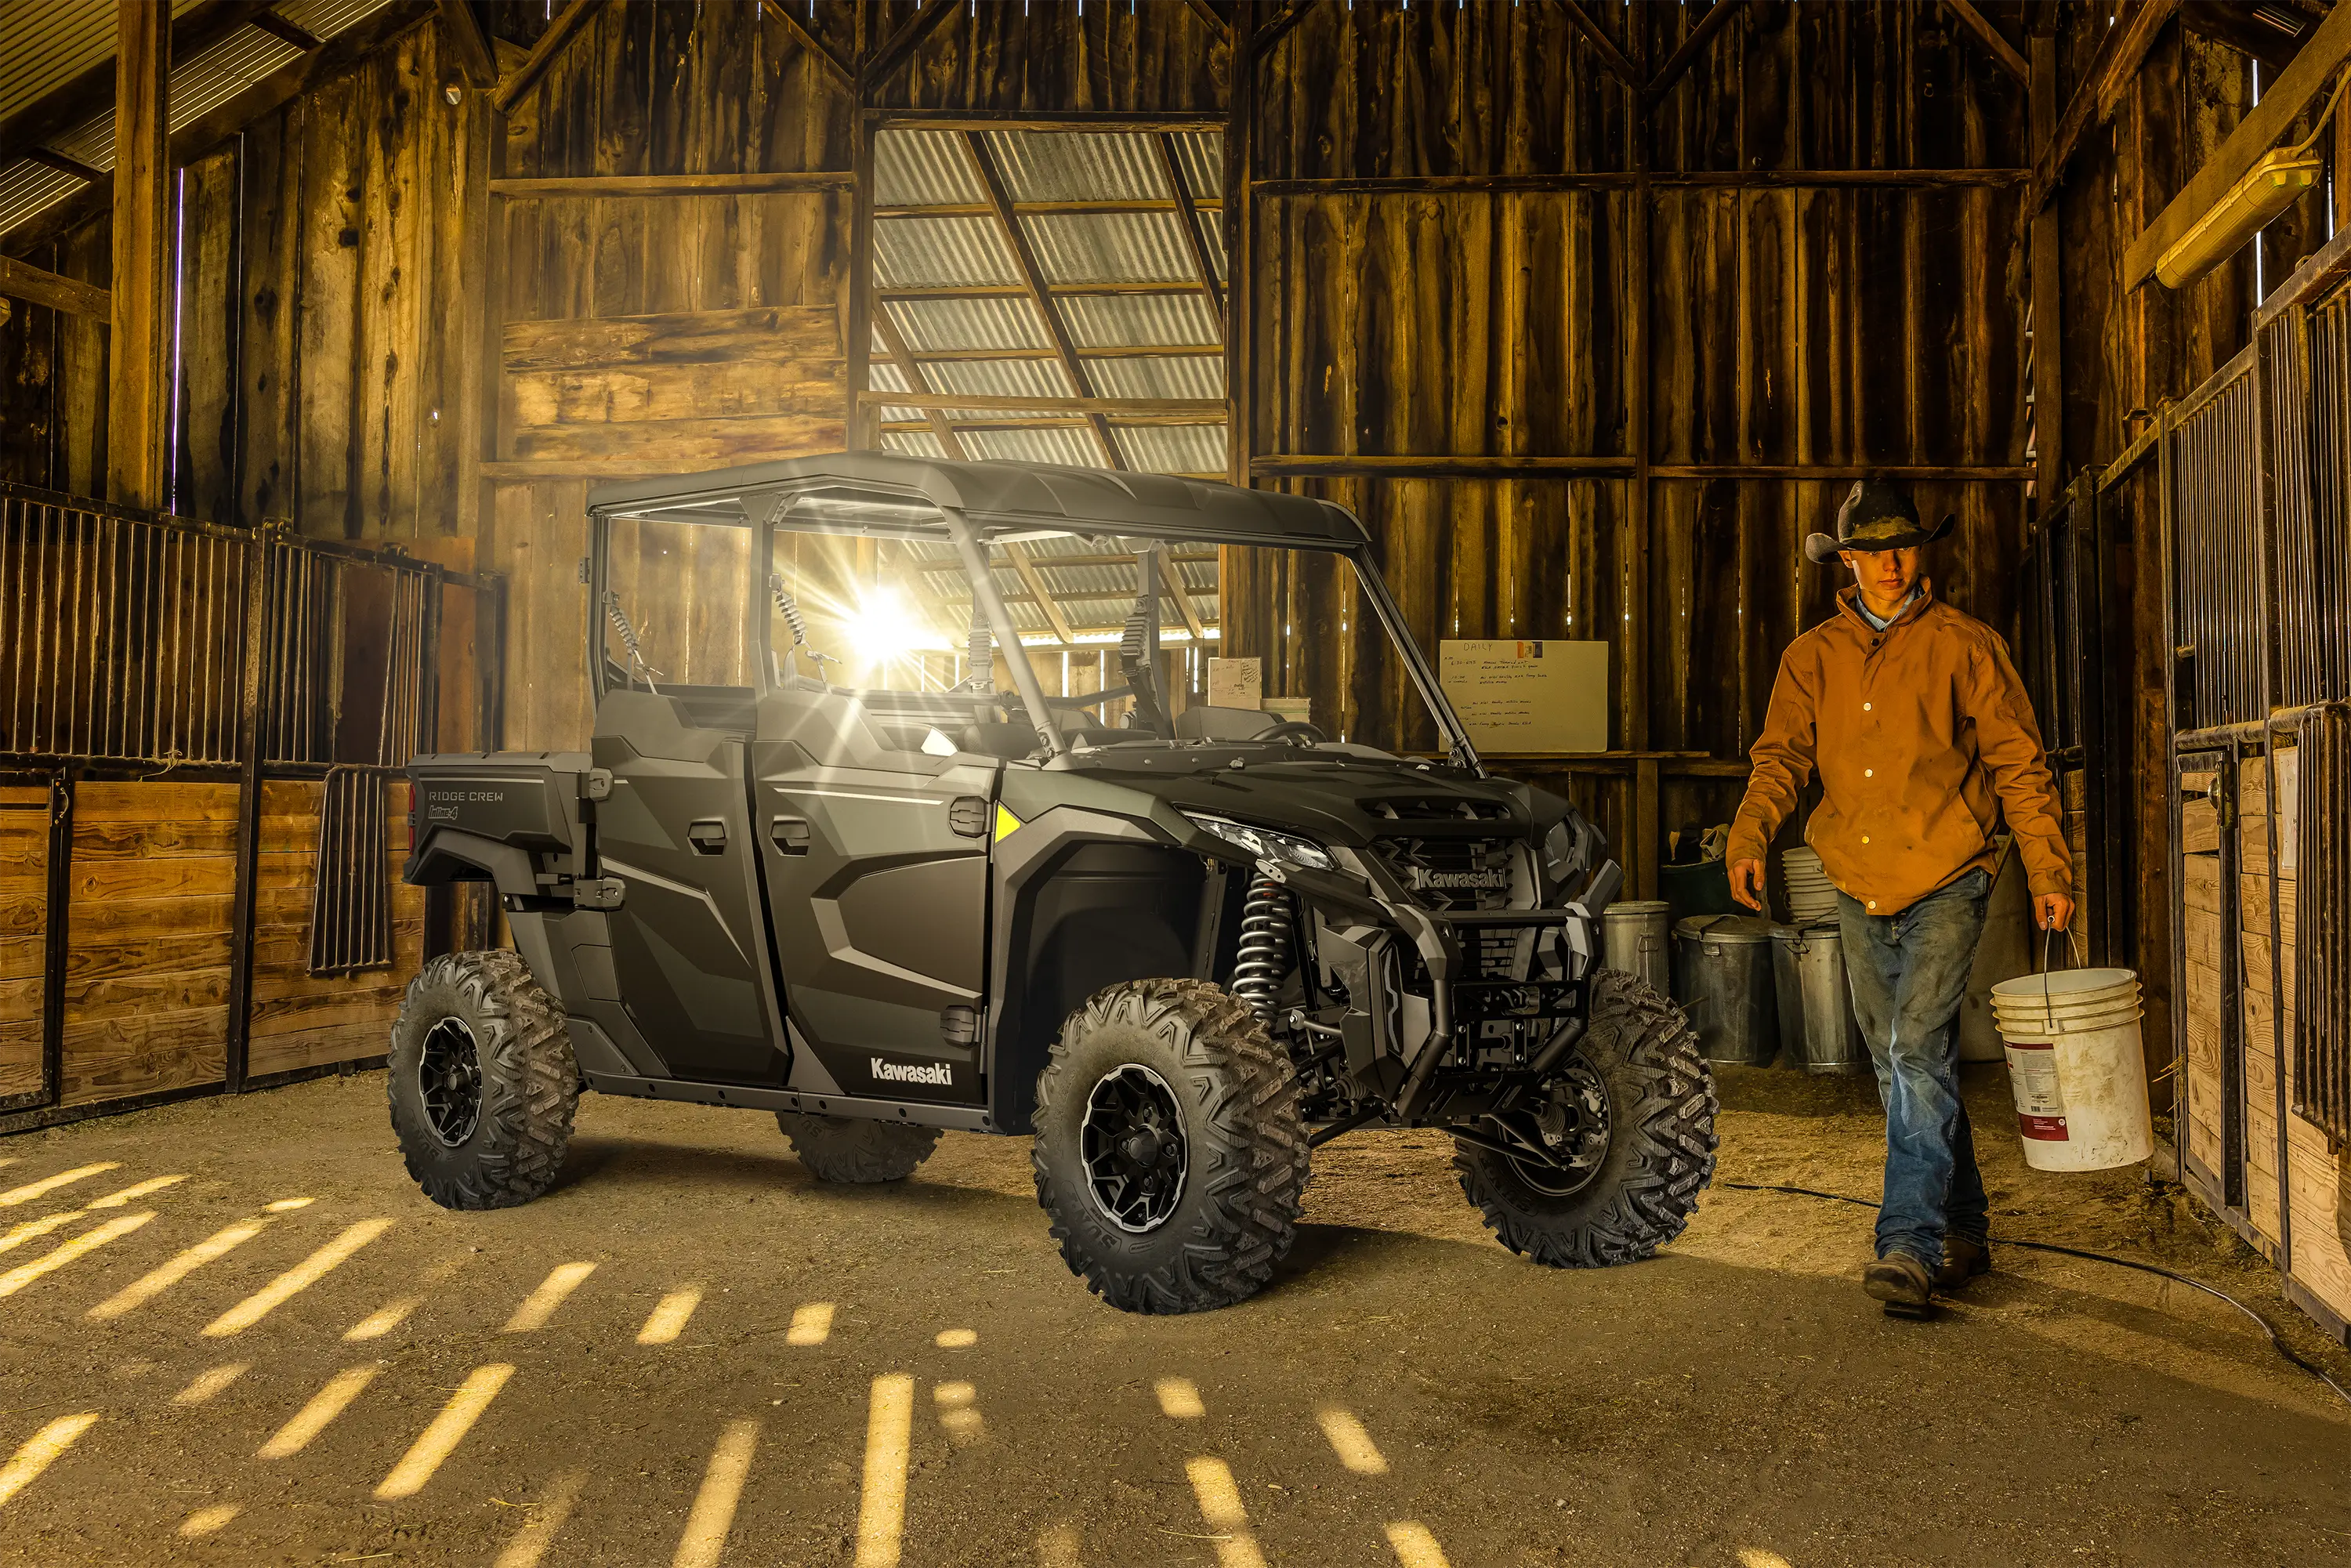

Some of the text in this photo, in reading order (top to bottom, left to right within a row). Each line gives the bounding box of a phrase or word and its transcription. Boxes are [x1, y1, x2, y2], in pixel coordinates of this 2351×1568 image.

[1463, 643, 1493, 652] DAILY
[429, 791, 503, 802] RIDGE CREW
[1418, 868, 1505, 888] Kawasaki
[871, 1057, 952, 1085] Kawasaki
